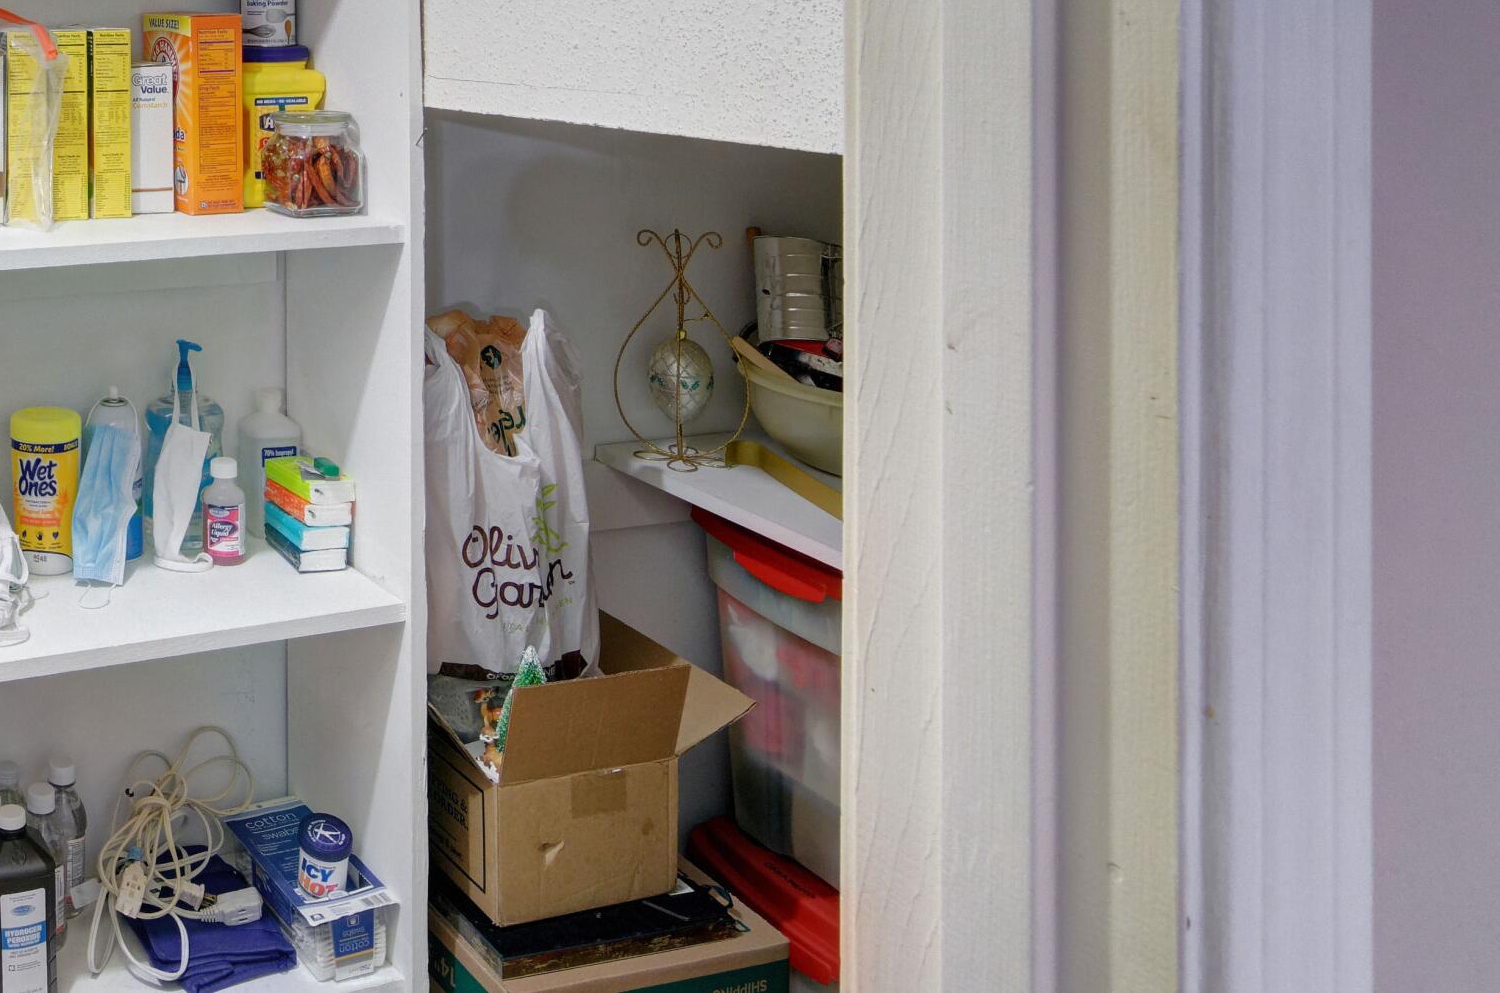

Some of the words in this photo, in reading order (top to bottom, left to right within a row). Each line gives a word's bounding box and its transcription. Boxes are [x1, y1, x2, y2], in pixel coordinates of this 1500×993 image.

[149, 18, 164, 28] VALUE
[166, 19, 180, 29] SIZE!
[131, 73, 168, 87] Great
[140, 86, 168, 94] Value
[19, 443, 33, 451] 20%
[33, 445, 54, 453] More!
[264, 449, 275, 457] 70%
[19, 457, 57, 481] Wet
[19, 478, 57, 497] Ones
[211, 522, 233, 532] Allergy
[211, 529, 230, 538] Liquid
[462, 525, 540, 569] Oliv
[245, 812, 297, 830] cotton
[301, 858, 334, 882] ICY
[299, 873, 338, 897] HOT
[5, 924, 42, 937] HYDROGEN
[6, 933, 41, 944] PEROXIDE
[339, 940, 370, 953] cotton
